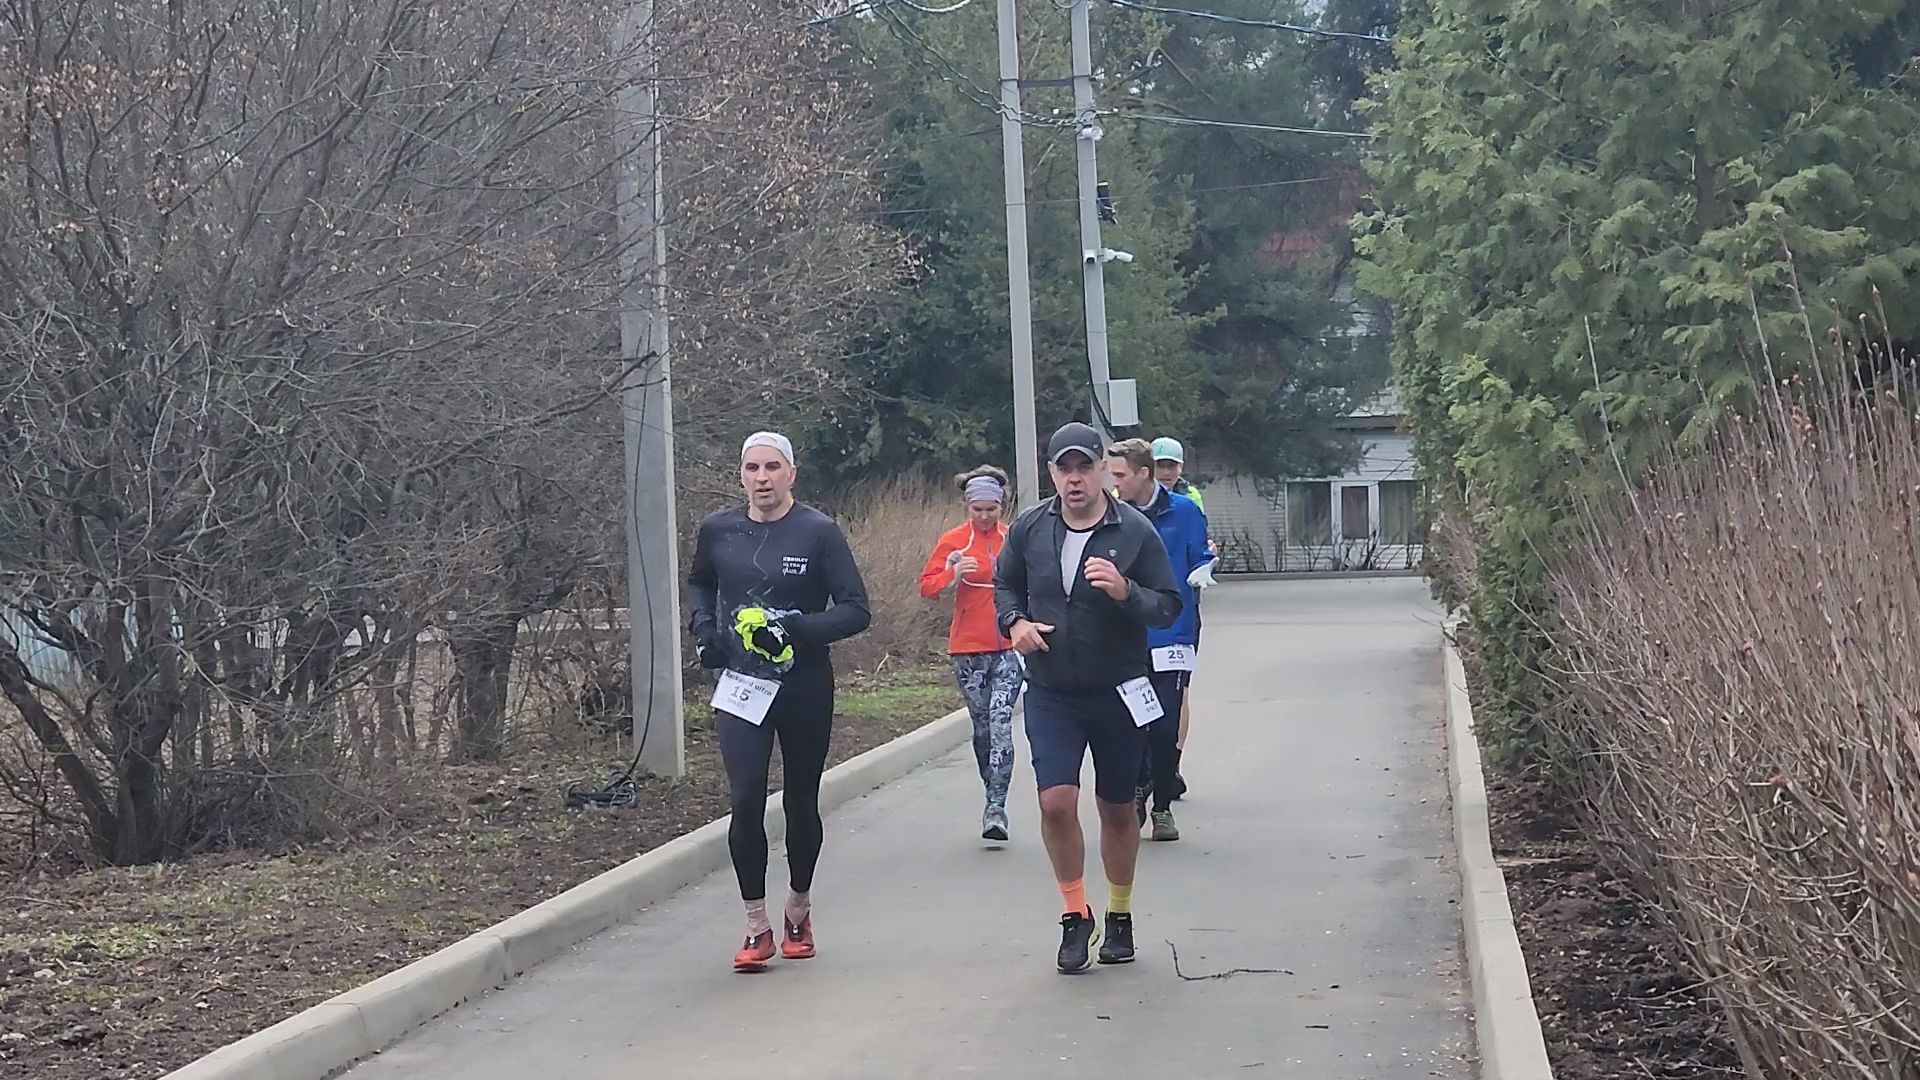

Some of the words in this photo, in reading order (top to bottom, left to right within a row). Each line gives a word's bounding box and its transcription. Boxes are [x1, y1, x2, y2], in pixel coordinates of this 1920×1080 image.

[1168, 650, 1184, 659] 25
[731, 685, 751, 701] 15
[754, 682, 772, 697] ultra
[1142, 689, 1155, 705] 12
